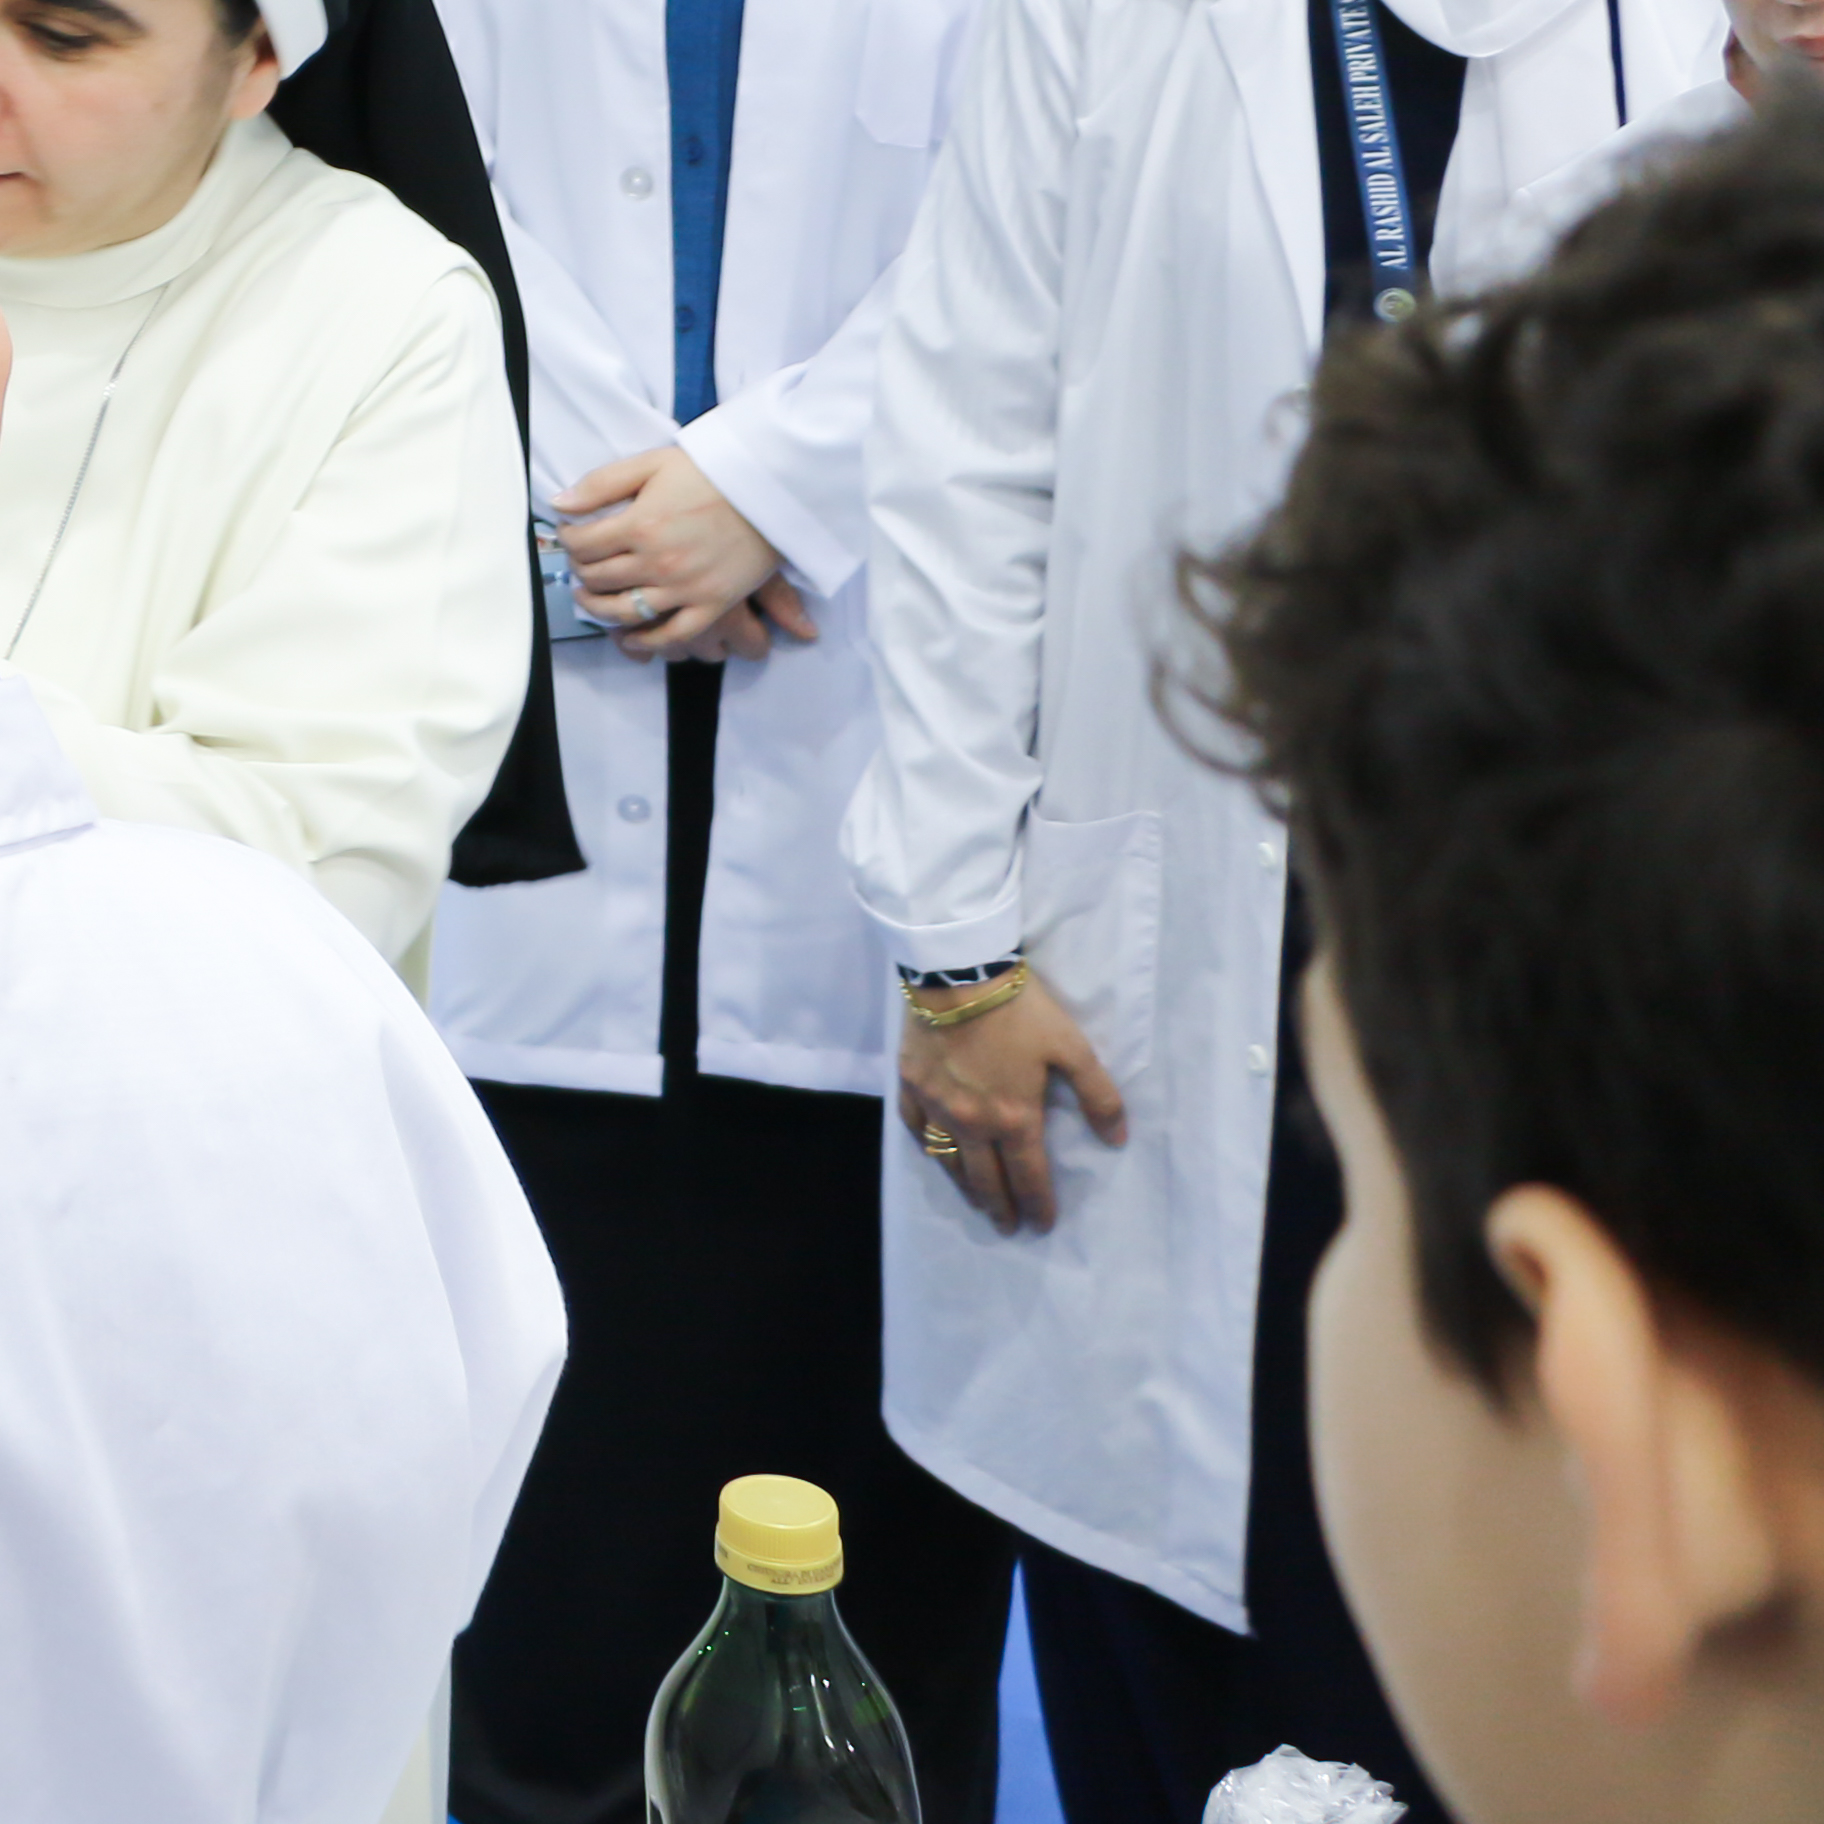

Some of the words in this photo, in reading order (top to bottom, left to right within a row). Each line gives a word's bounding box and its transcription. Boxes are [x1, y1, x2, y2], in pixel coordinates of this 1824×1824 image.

[1338, 6, 1379, 82] PRIVATE
[1351, 85, 1389, 144] SALEH
[1361, 145, 1394, 171] AL
[1366, 173, 1404, 241] RASHID
[1376, 244, 1408, 270] AL
